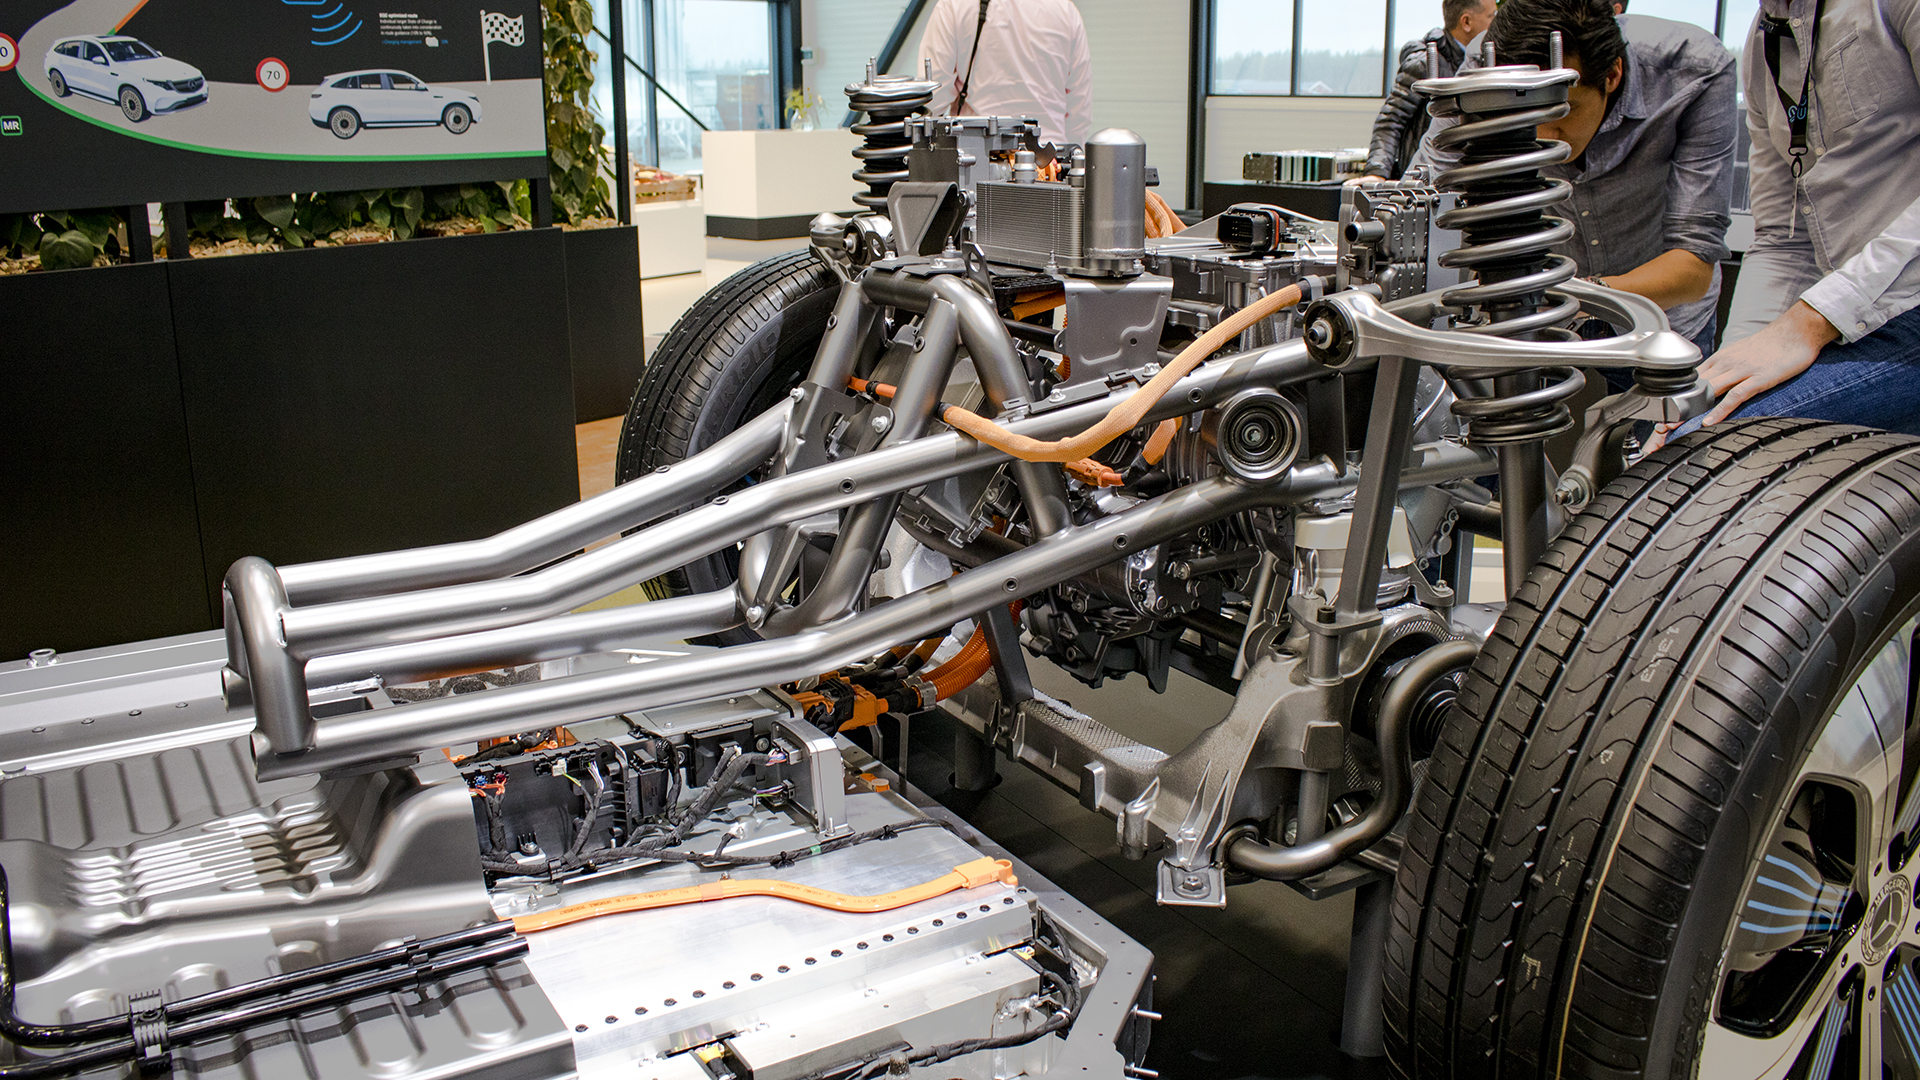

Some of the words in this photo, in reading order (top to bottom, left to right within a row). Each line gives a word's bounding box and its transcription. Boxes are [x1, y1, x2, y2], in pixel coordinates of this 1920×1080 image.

[0, 46, 8, 57] 0
[266, 70, 280, 80] 70
[3, 121, 19, 130] MR
[1873, 878, 1907, 906] MERCEDES
